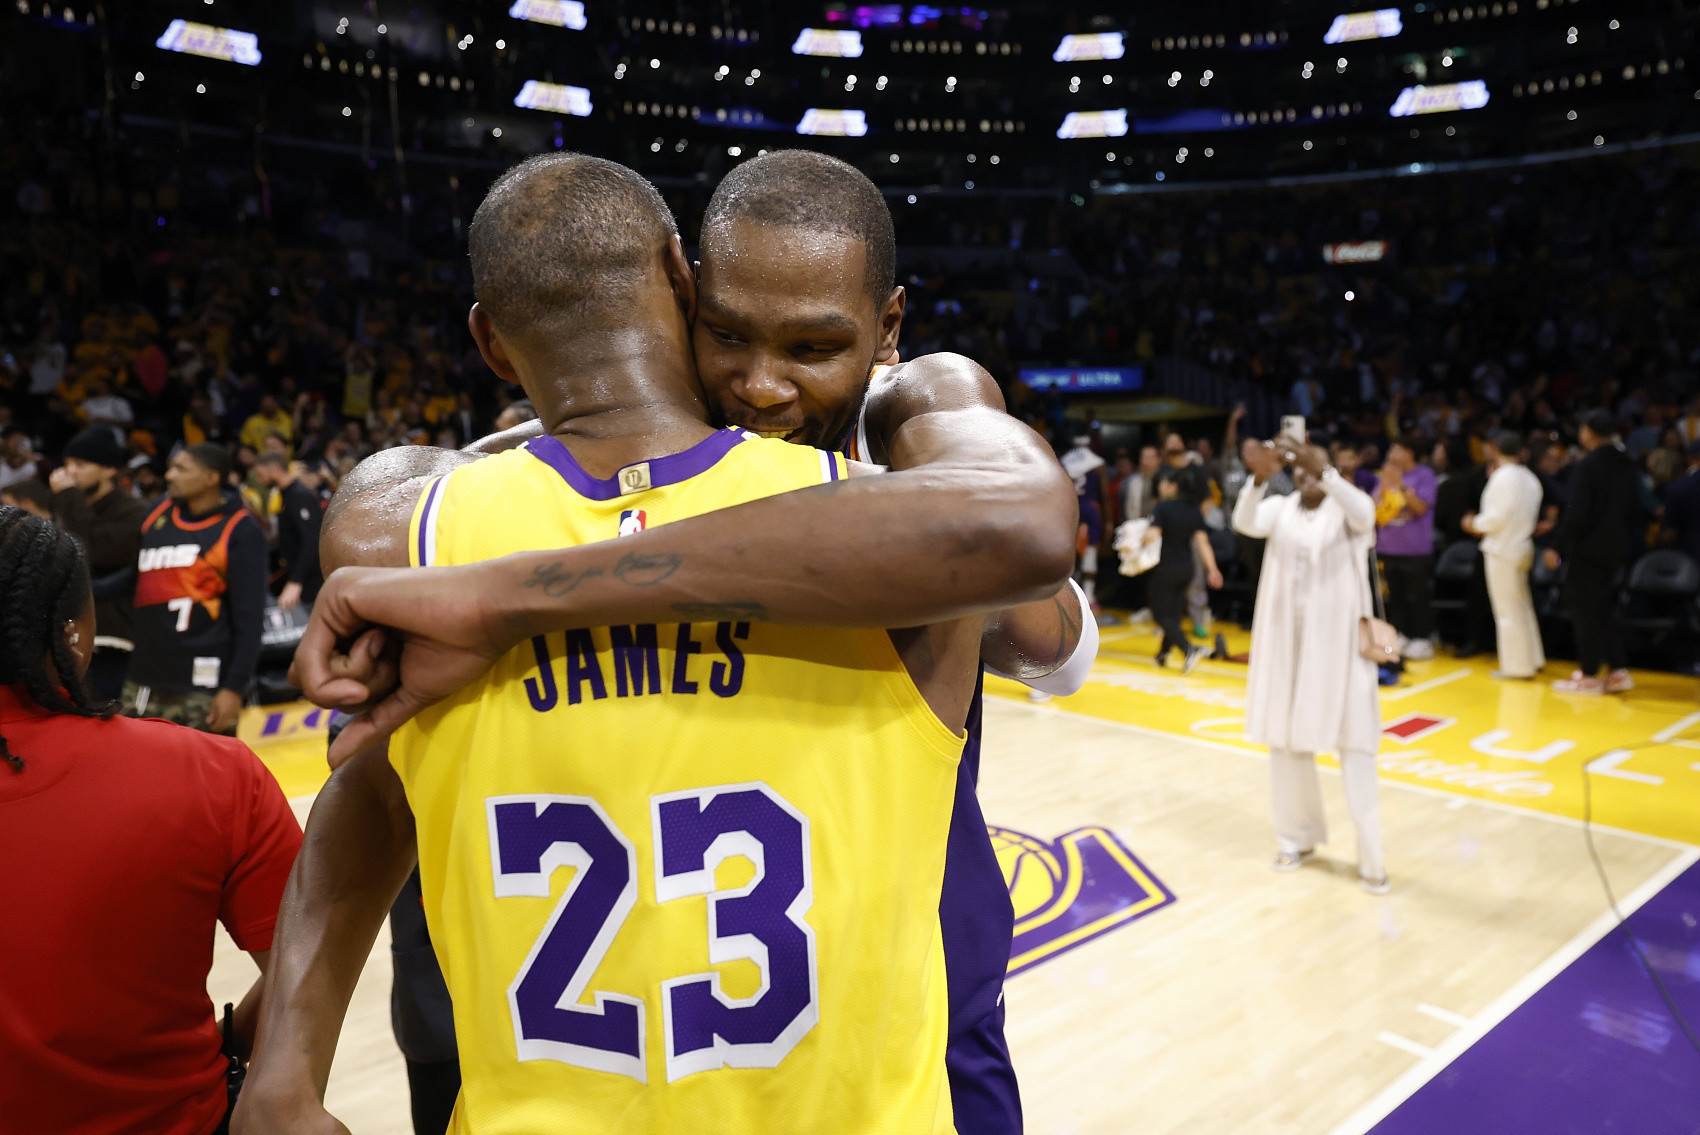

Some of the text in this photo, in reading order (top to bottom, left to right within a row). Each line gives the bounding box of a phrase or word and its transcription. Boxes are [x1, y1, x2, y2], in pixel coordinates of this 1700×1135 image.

[168, 597, 193, 632] 7
[523, 621, 751, 713] JAMES
[485, 780, 820, 1085] 23
